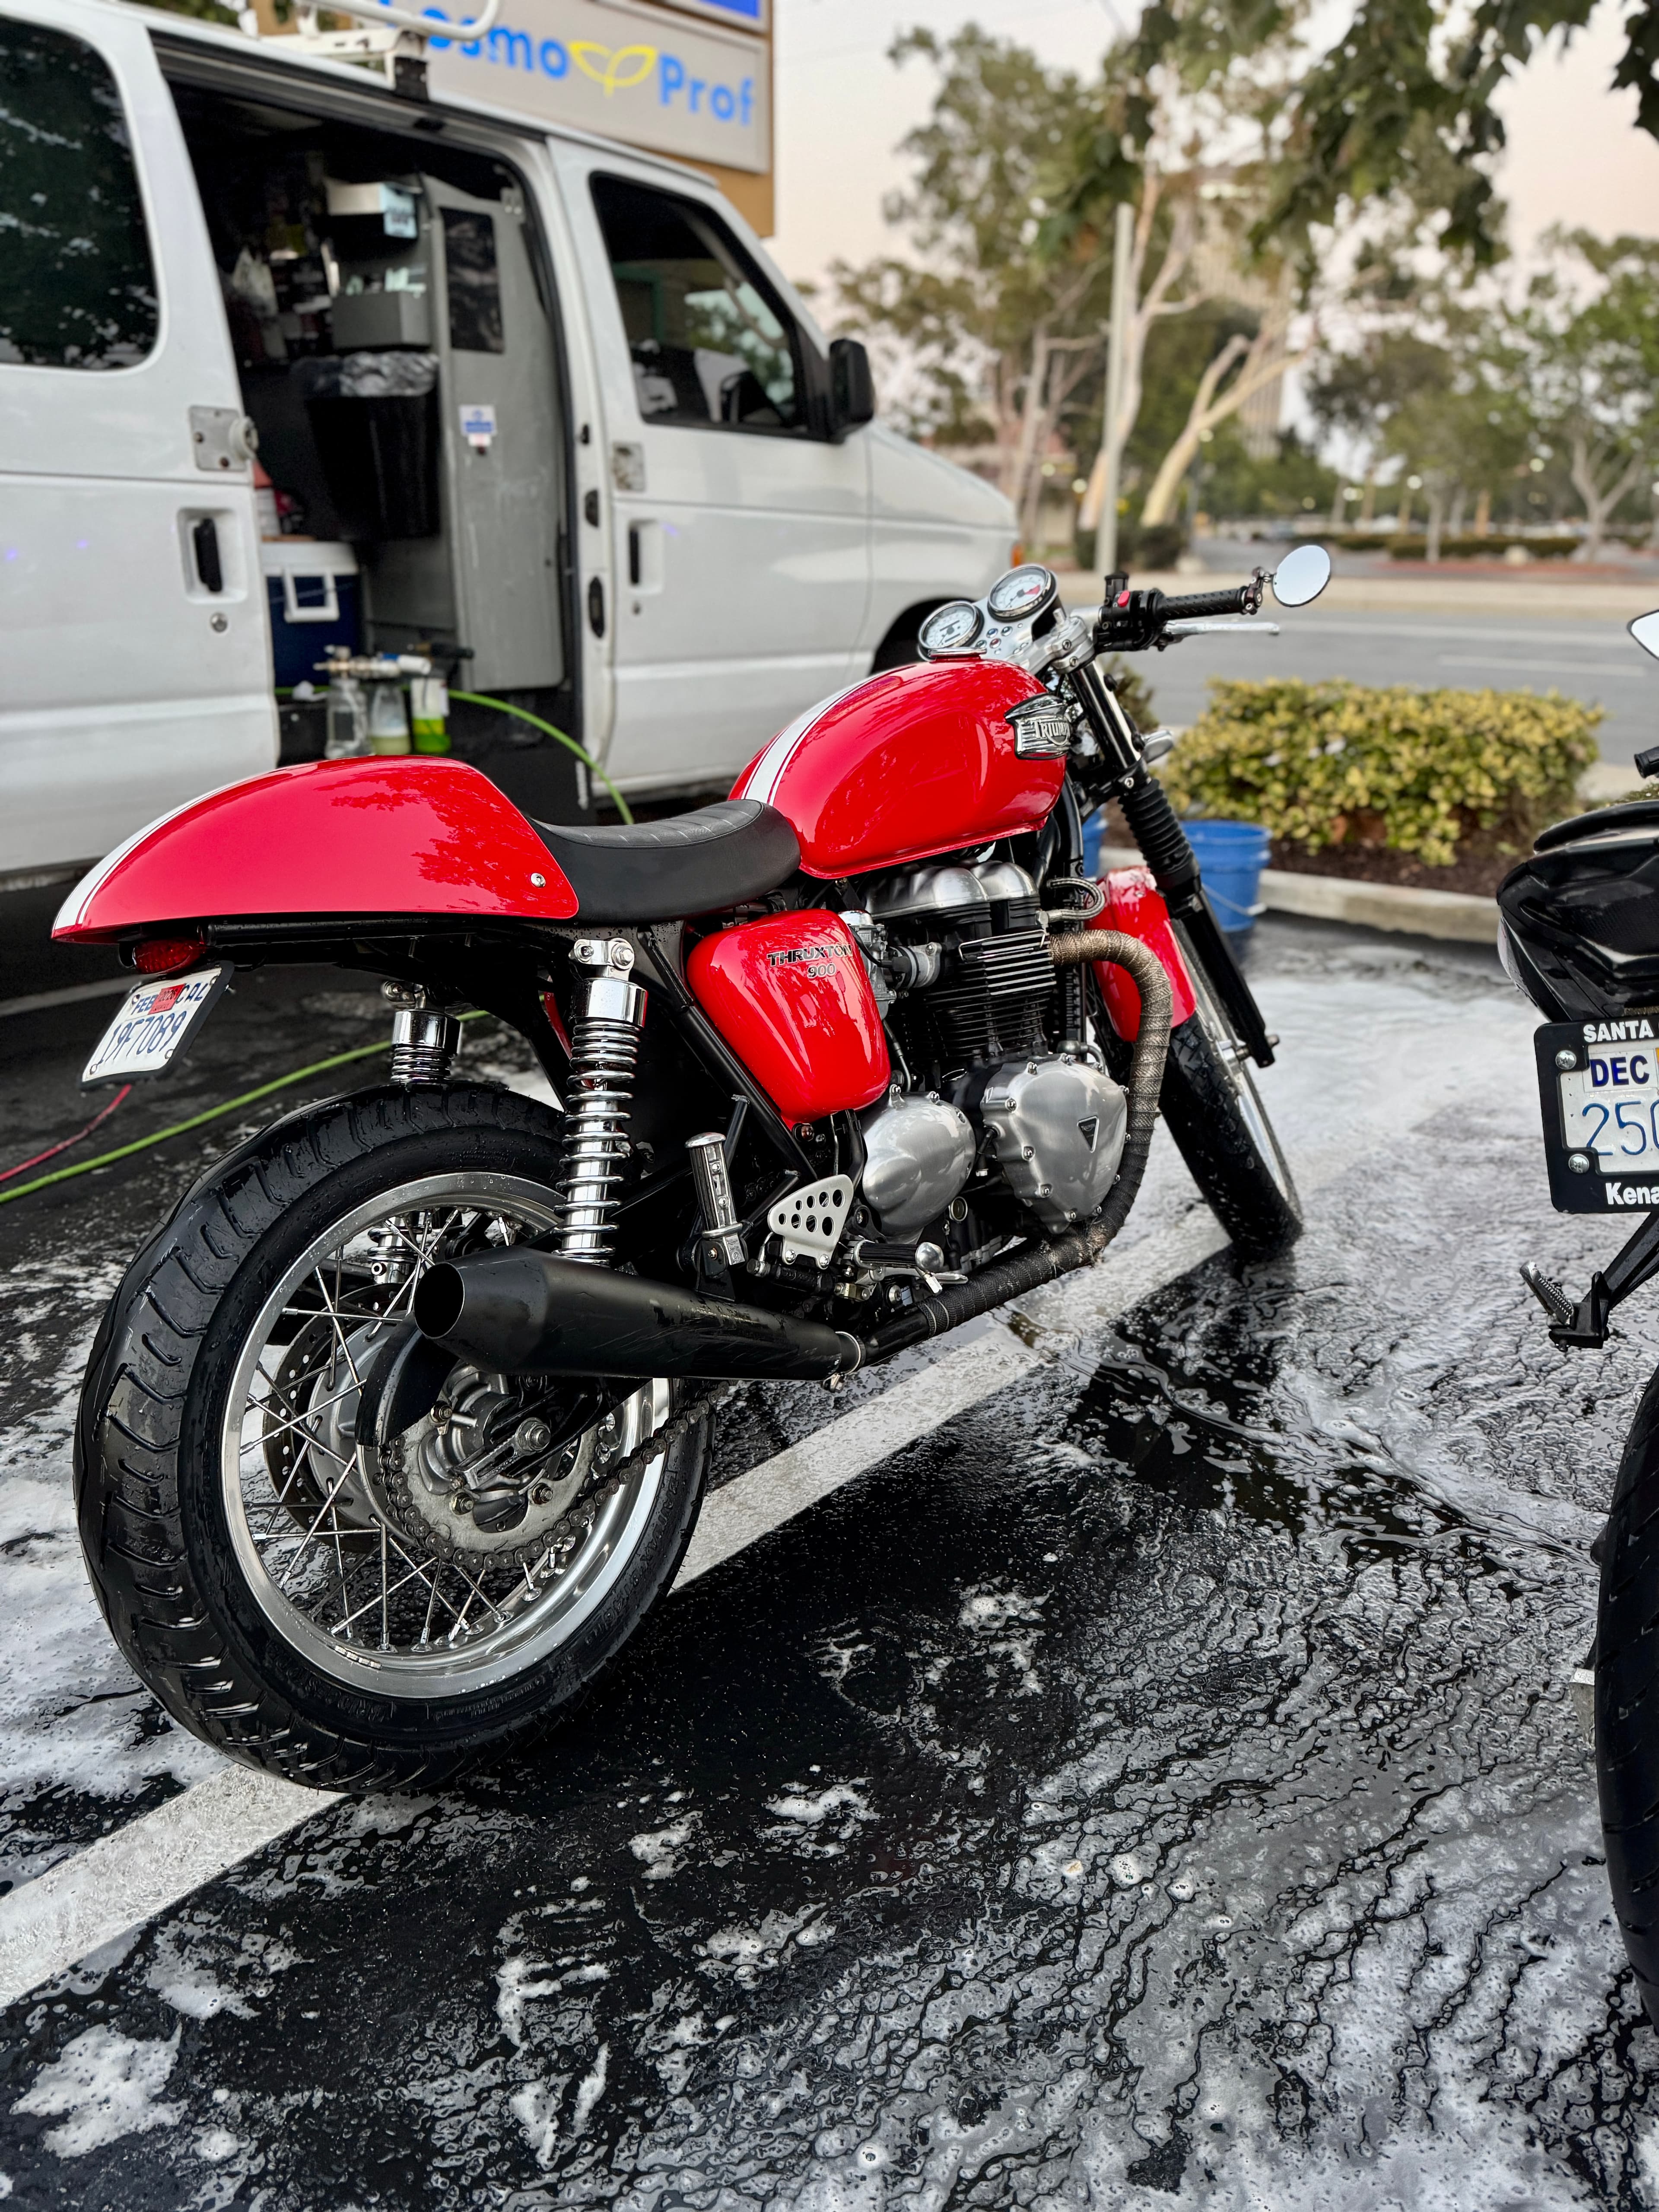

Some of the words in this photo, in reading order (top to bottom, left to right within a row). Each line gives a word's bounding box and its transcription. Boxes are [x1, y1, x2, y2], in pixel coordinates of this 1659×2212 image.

[376, 0, 569, 79] osmo
[658, 53, 755, 125] Prof
[767, 944, 853, 967] THRUXTON
[807, 963, 836, 979] 900
[131, 994, 159, 1015] FEB
[175, 982, 208, 1004] CAL
[96, 1011, 187, 1065] 19F7089
[1583, 1020, 1654, 1042] SANTA
[1589, 1055, 1649, 1088] DEC
[1605, 1182, 1659, 1205] Kena
